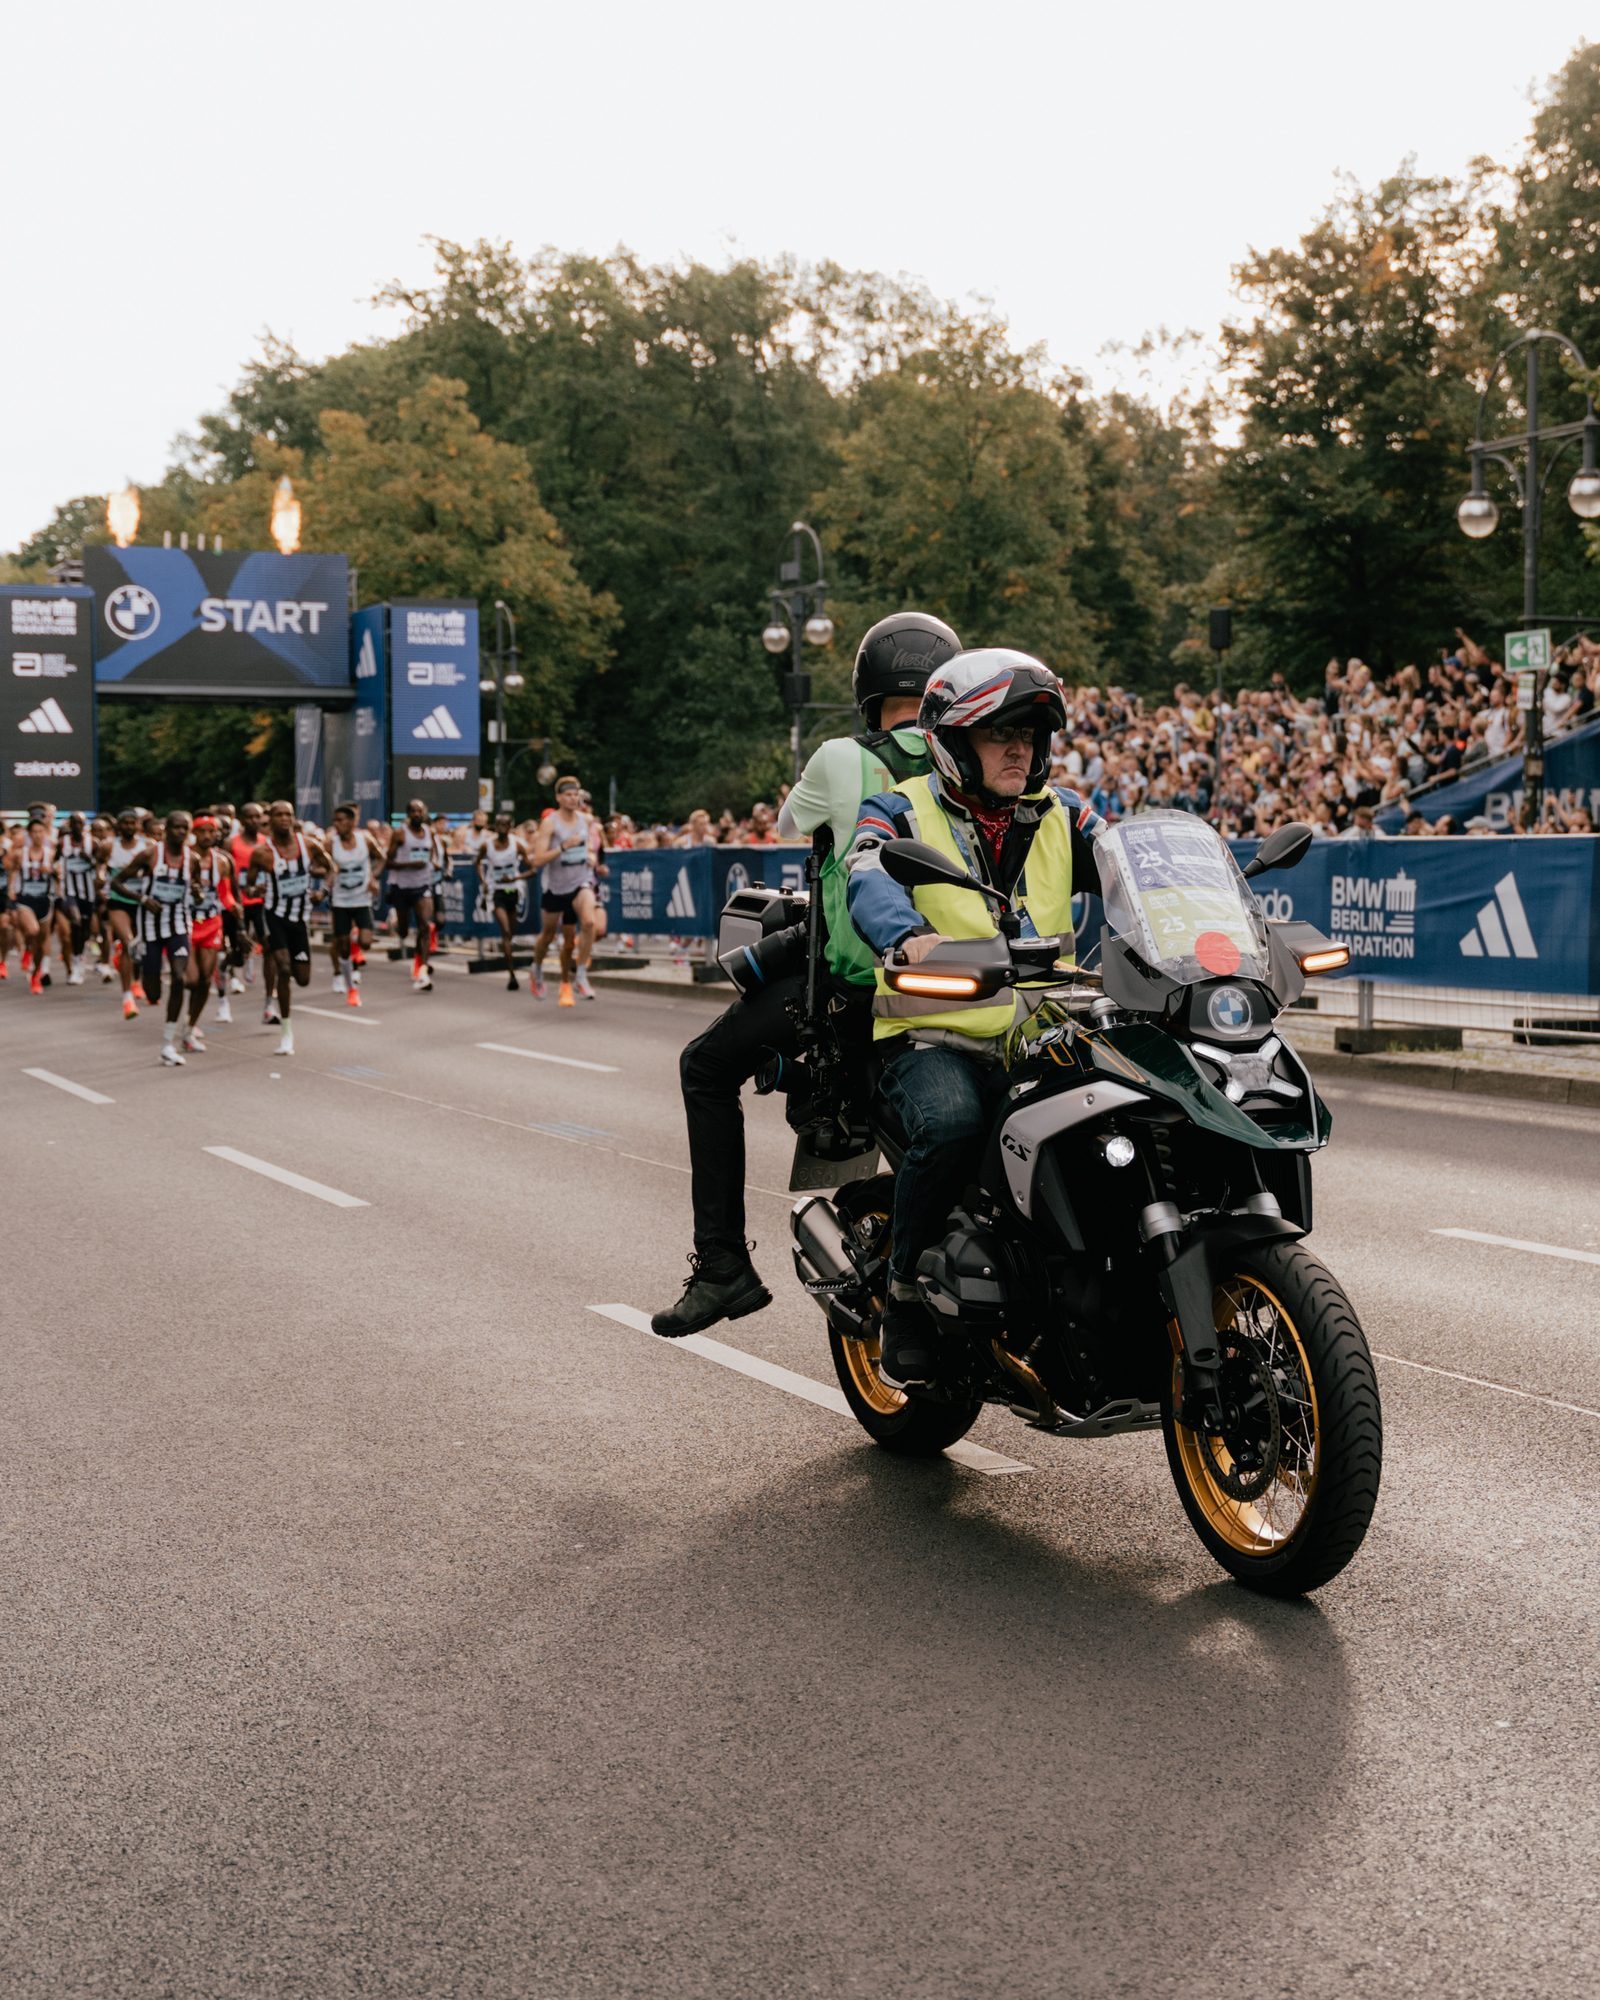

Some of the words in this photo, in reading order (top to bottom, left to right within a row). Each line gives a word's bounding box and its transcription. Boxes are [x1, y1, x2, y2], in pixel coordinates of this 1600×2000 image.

[200, 598, 328, 634] START
[14, 760, 81, 777] zalando
[1136, 851, 1163, 869] 25
[1331, 875, 1386, 909] BMW
[1159, 916, 1186, 934] 25
[1330, 908, 1384, 932] BERLIN
[1002, 1134, 1032, 1162] GS
